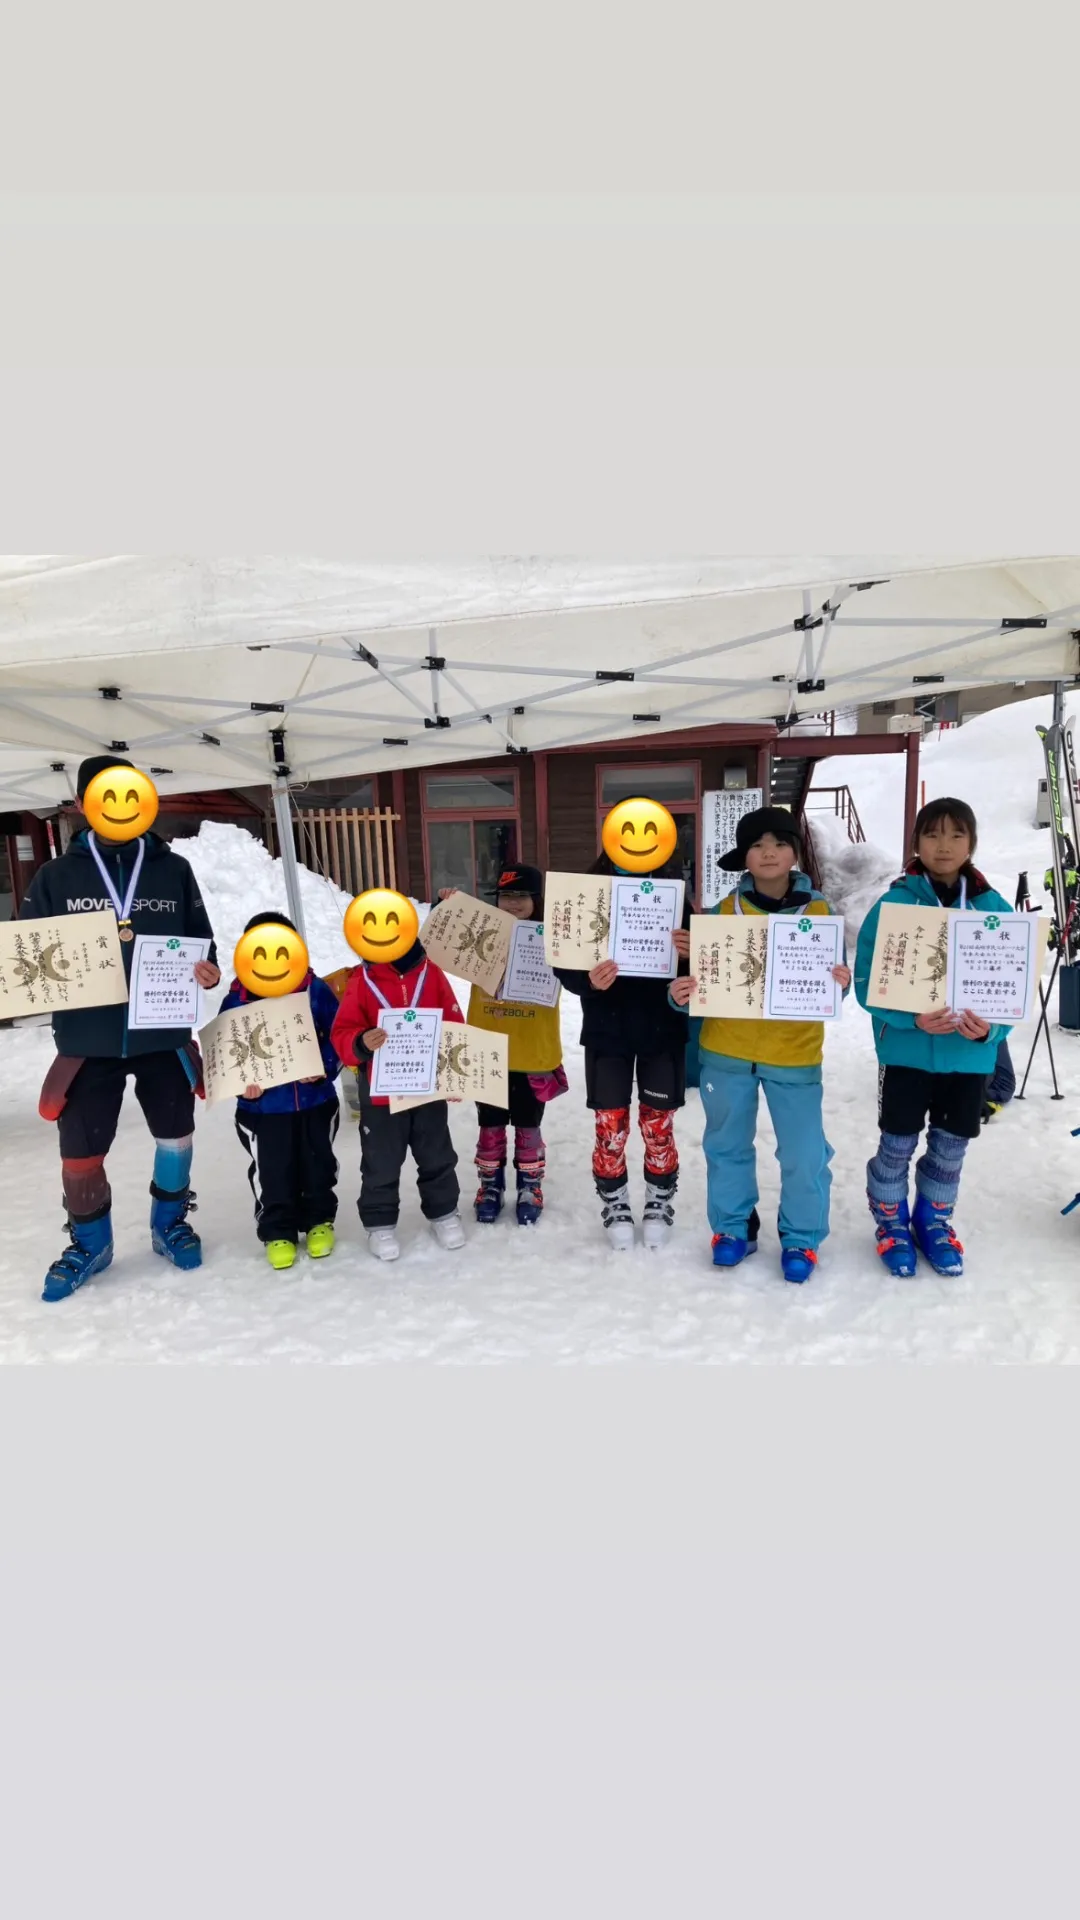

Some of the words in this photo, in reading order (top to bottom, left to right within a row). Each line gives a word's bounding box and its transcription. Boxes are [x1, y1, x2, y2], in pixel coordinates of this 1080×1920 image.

[1048, 750, 1064, 835] FISCHER
[631, 893, 661, 904] 賞状
[131, 898, 178, 913] SPORT
[788, 931, 821, 943] 賞状
[972, 929, 1011, 941] 賞状
[95, 935, 116, 970] 賞状
[156, 949, 188, 958] 賞状
[293, 1013, 312, 1044] 賞状
[395, 1022, 423, 1031] 賞状
[490, 1051, 503, 1079] 賞状
